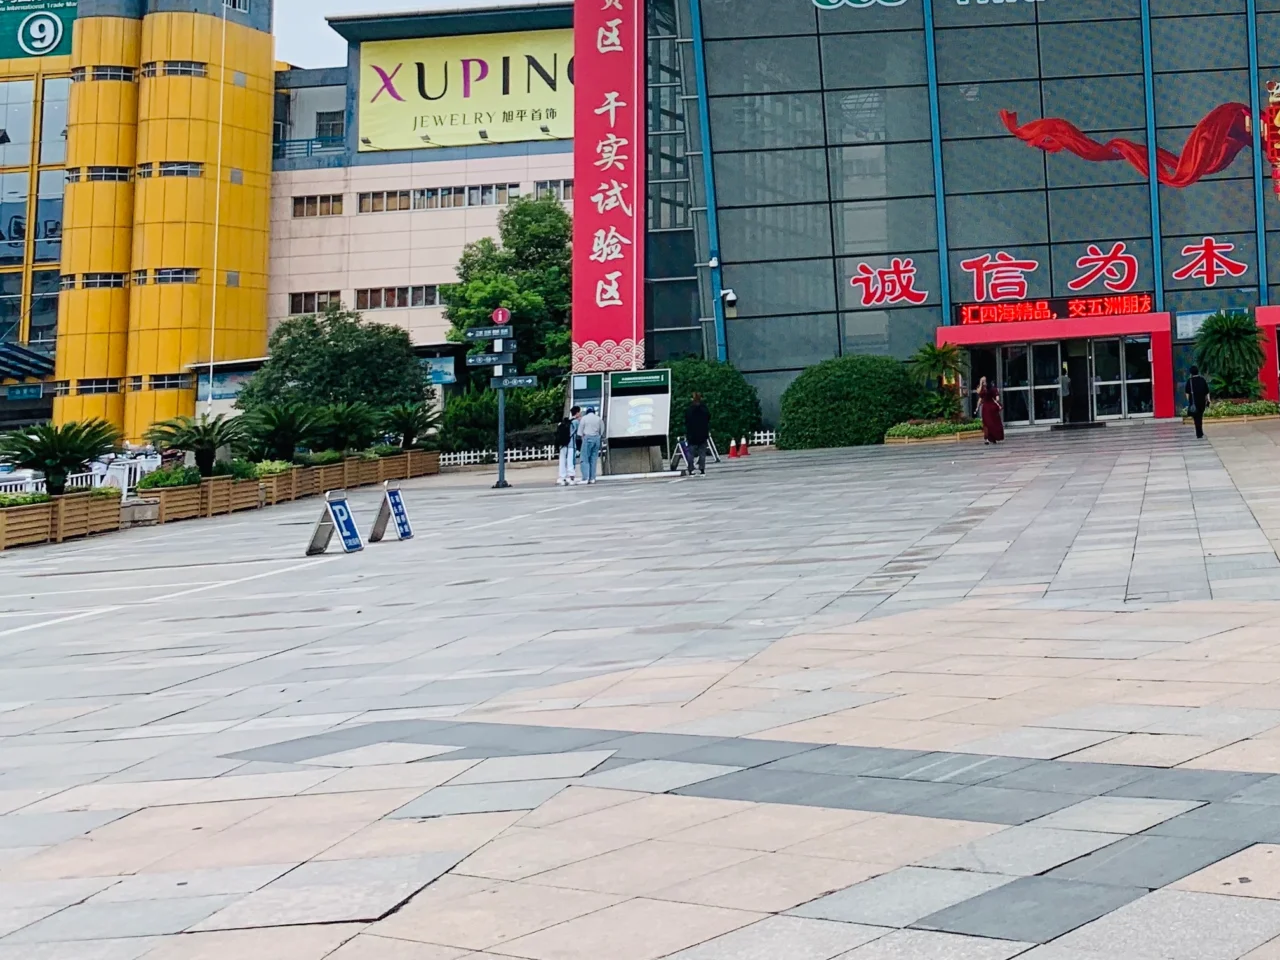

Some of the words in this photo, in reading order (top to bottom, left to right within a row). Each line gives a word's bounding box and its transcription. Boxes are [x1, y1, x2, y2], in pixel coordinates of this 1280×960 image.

[369, 52, 575, 103] XUPIN
[412, 111, 497, 131] JEWELRY
[501, 108, 558, 123] 旭平首饰
[589, 90, 633, 307] 干实试验区
[850, 236, 1249, 305] 诚信为本
[332, 504, 351, 537] P
